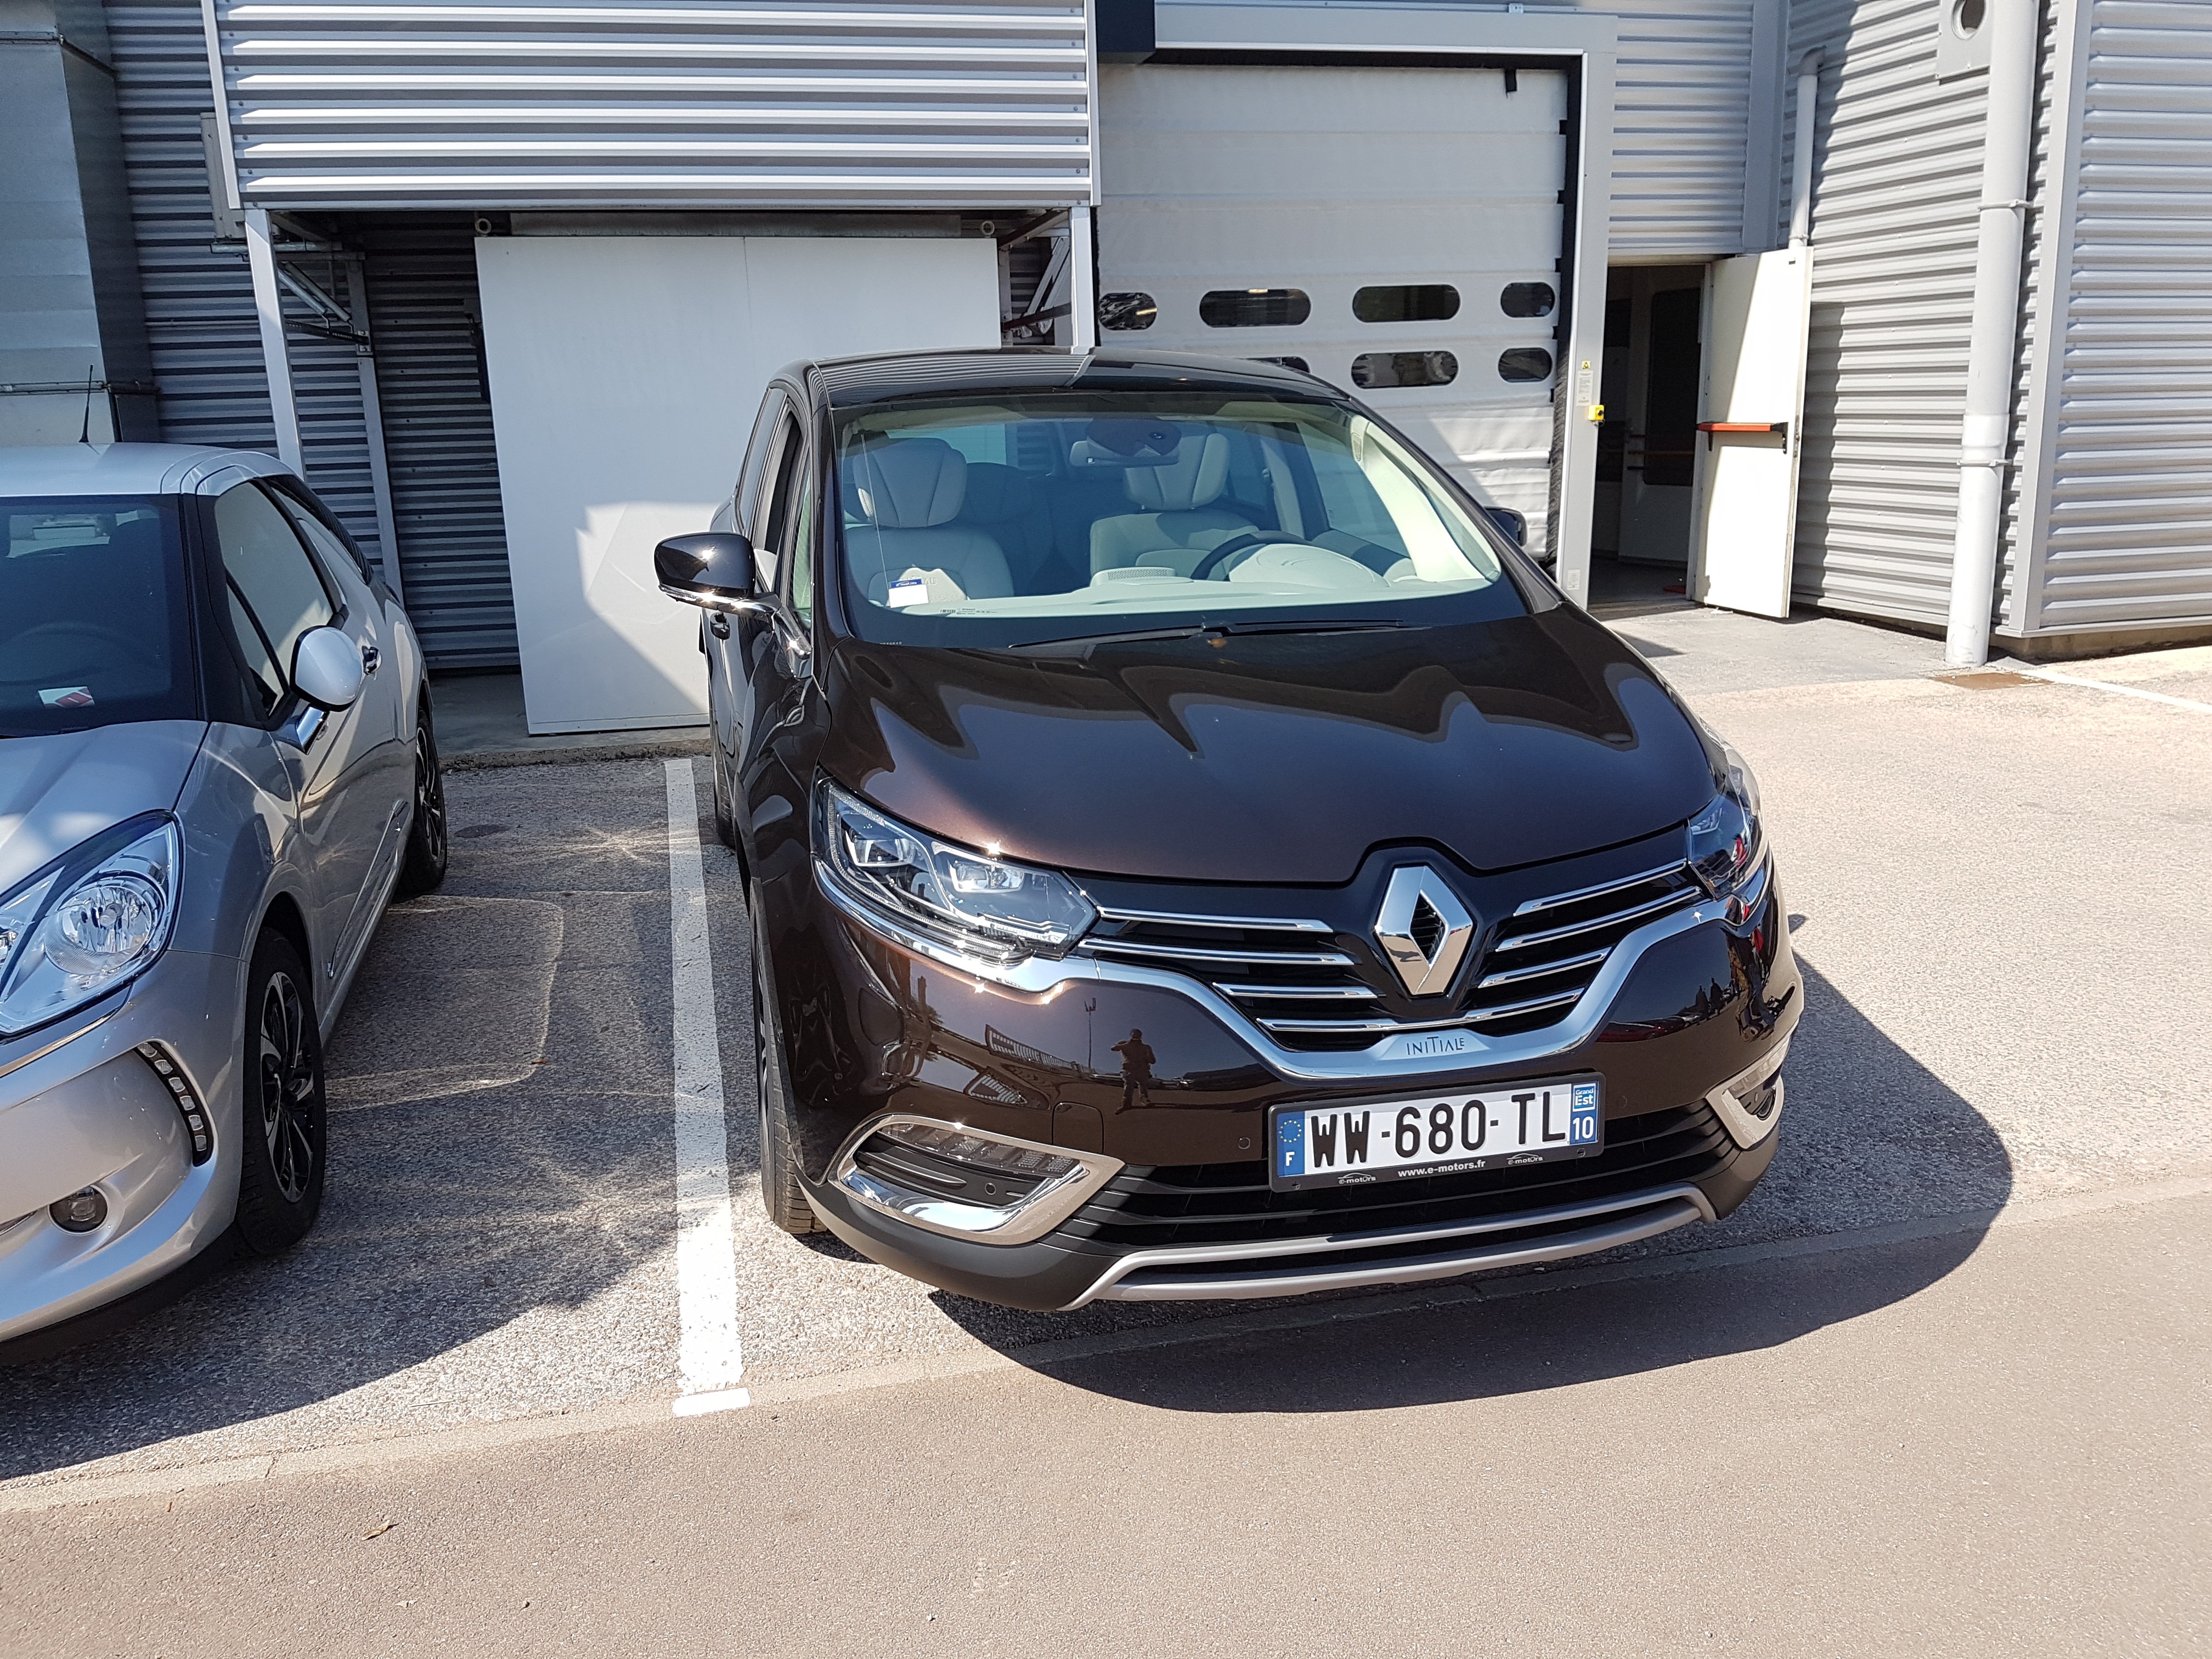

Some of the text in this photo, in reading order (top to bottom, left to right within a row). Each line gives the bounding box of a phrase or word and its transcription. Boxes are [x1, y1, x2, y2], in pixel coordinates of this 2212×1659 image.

[1407, 1036, 1465, 1055] INITIALE
[1575, 1094, 1594, 1106] Est
[1311, 1092, 1566, 1168] WW-680-TL
[1573, 1116, 1594, 1140] 10
[1285, 1152, 1295, 1166] F
[1398, 1160, 1486, 1177] www.e-motors.fr
